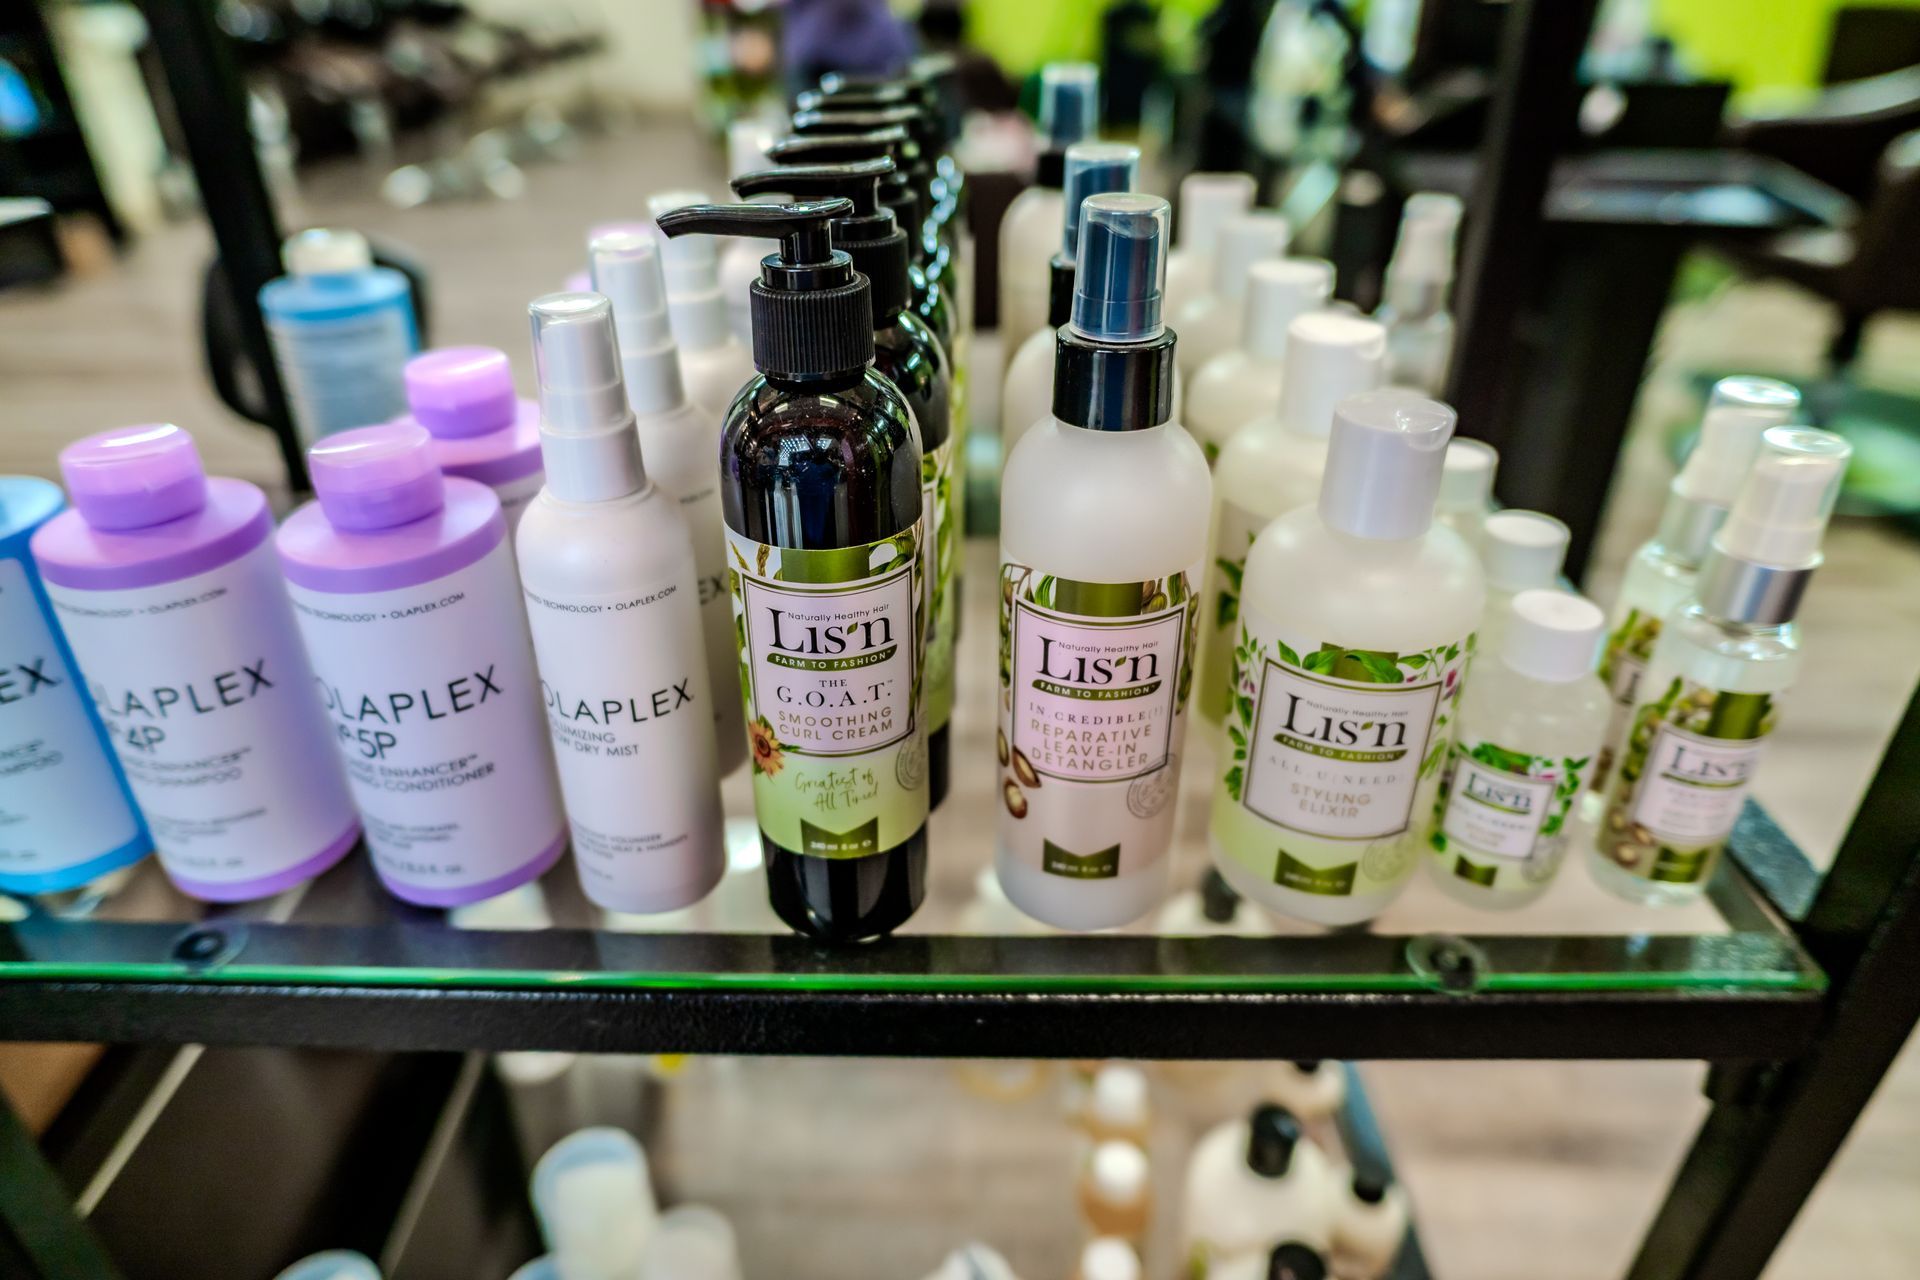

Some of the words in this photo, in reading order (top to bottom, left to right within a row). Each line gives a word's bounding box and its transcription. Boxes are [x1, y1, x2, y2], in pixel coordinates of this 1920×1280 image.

[390, 592, 465, 620] OLAPLEX.COM
[615, 585, 677, 611] OLAPLEX.COM
[788, 612, 830, 622] Naturally
[835, 608, 870, 621] Healthy
[873, 603, 890, 614] Hair
[1058, 642, 1101, 653] Naturally
[1105, 644, 1139, 654] Healthy
[1142, 641, 1158, 649] Hair
[775, 655, 806, 668] FARM
[811, 661, 827, 669] TO
[819, 679, 848, 688] THE
[1040, 683, 1071, 697] FARM
[1076, 690, 1091, 698] TO
[779, 706, 892, 728] SMOOTHING
[779, 724, 822, 741] CURL
[832, 719, 893, 741] CREAM
[1031, 719, 1152, 743] REPARATIVE
[574, 741, 600, 755] DRY
[606, 744, 639, 757] MIST
[1044, 738, 1137, 757] LEAVE-IN
[1283, 736, 1314, 752] FARM
[1319, 747, 1335, 757] TO
[1032, 747, 1148, 771] DETANGLER
[384, 762, 494, 792] CONDITIONER
[814, 792, 836, 812] All
[1290, 783, 1371, 806] STYLING
[1299, 798, 1360, 818] ELIXIR
